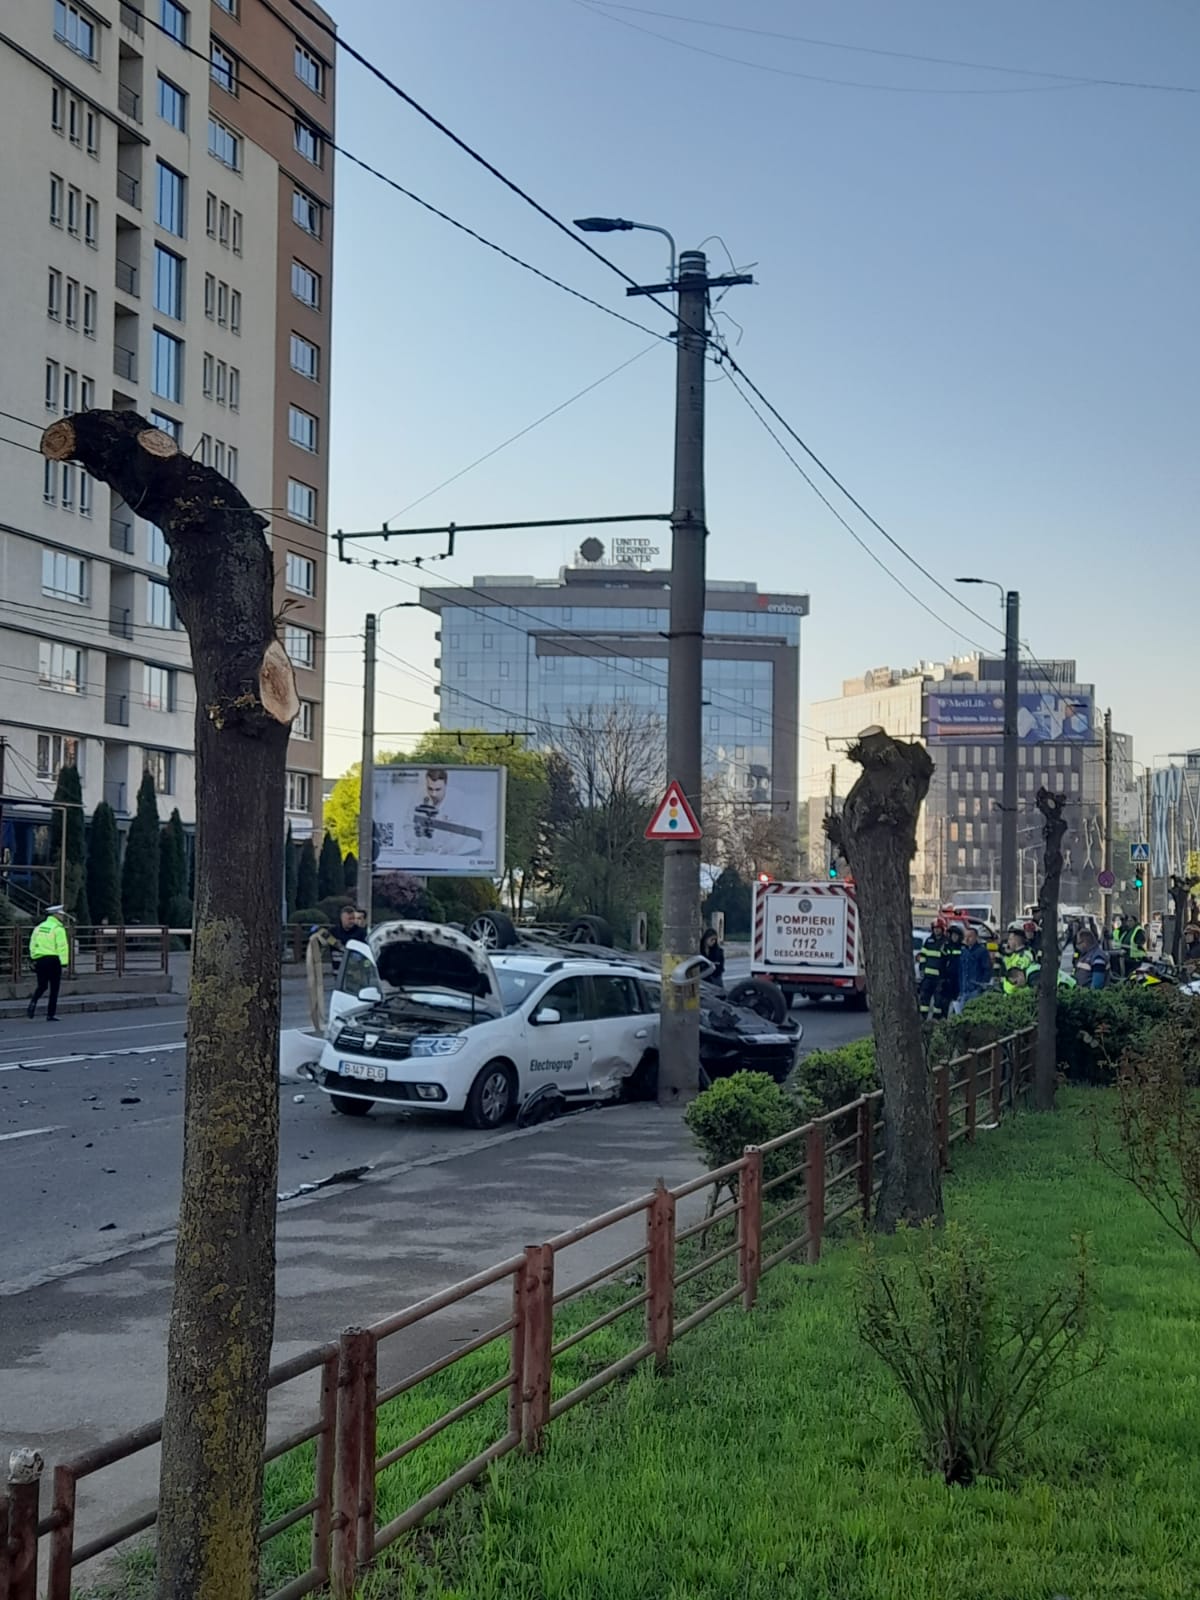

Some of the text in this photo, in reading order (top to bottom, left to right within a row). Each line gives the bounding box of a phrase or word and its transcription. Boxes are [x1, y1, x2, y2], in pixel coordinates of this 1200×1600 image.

[616, 538, 650, 546] UNITED
[616, 546, 660, 555] BUSINESS
[616, 554, 651, 563] CENTER
[775, 914, 835, 926] POMPIERII
[785, 925, 825, 937] SMURD
[797, 938, 818, 950] 112
[773, 949, 835, 960] DESCARCERARE
[529, 1058, 573, 1073] Electrogrup
